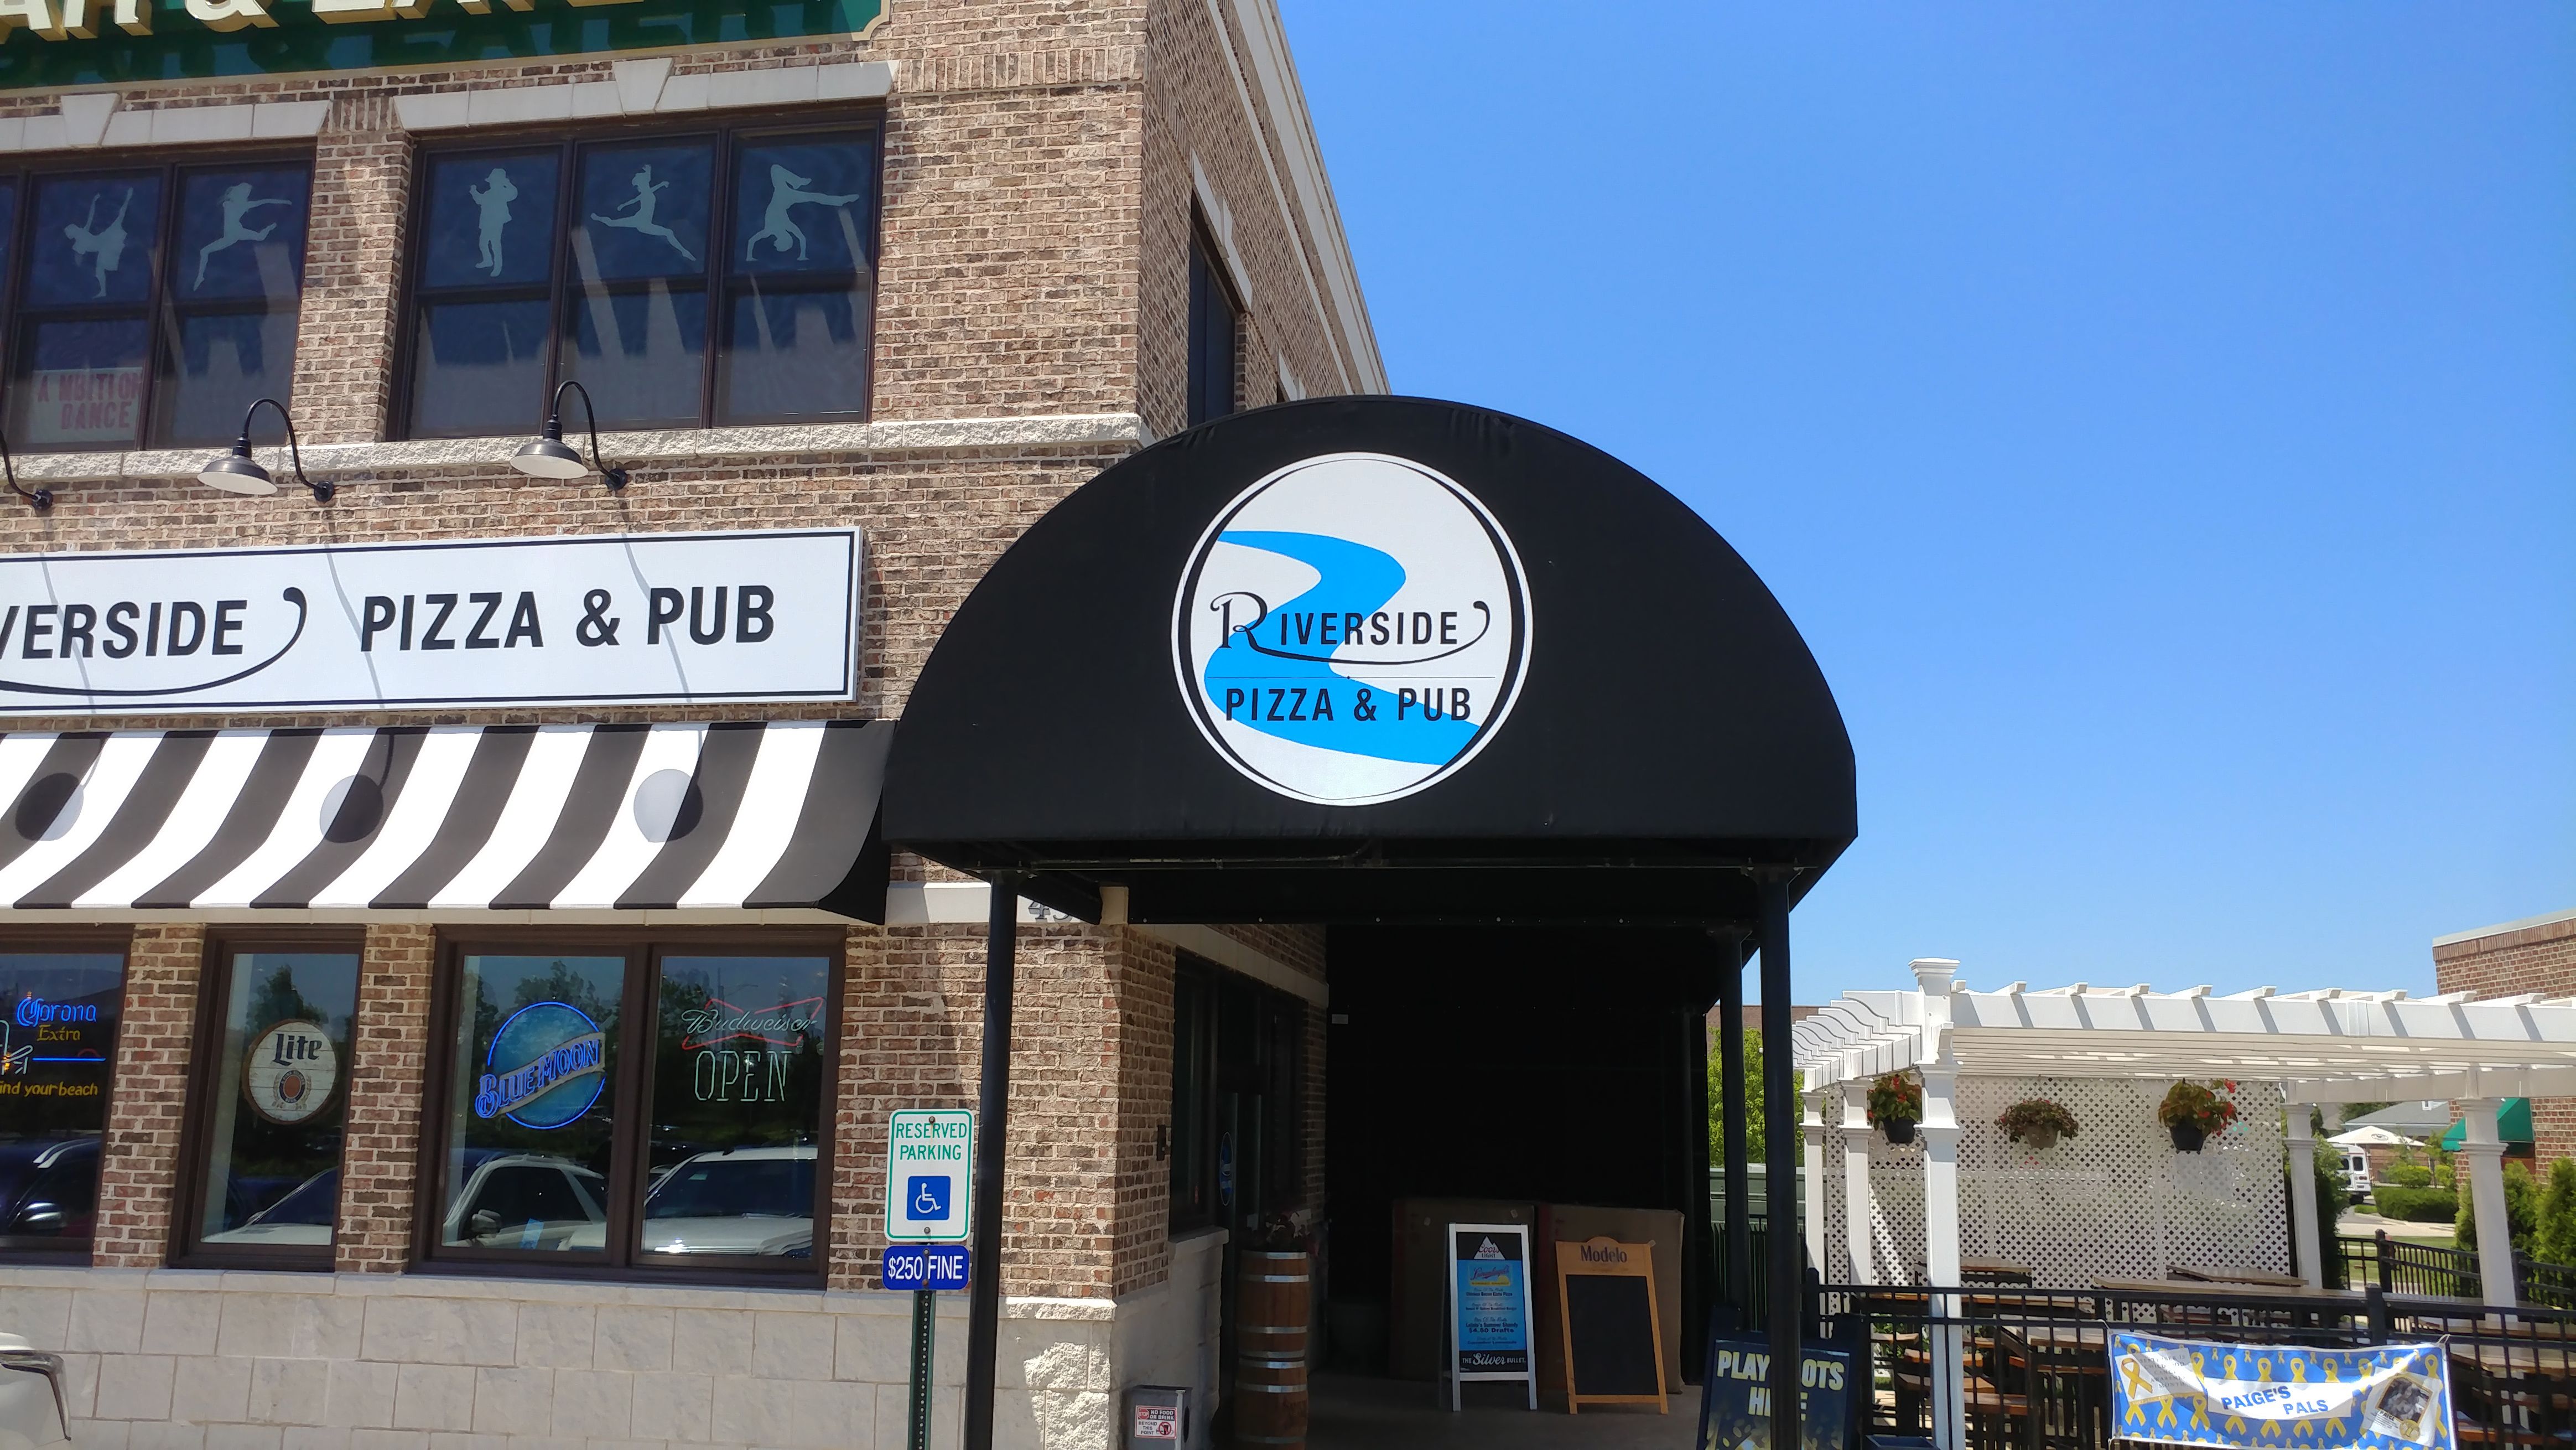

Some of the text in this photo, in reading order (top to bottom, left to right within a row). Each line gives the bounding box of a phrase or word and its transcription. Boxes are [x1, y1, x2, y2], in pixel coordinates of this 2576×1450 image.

[61, 401, 132, 430] DANCE
[361, 591, 543, 652] PIZZA
[576, 589, 620, 646] &
[647, 585, 774, 645] PUB
[1226, 688, 1471, 721] PIZZA & PUB
[17, 998, 97, 1027] Corona
[681, 1008, 817, 1034] Budweiser
[37, 1024, 81, 1041] Extra
[272, 1033, 323, 1066] Lite
[475, 1039, 600, 1118] BLUE MOON
[694, 1050, 792, 1101] OPEN
[24, 1084, 58, 1097] your
[58, 1081, 98, 1096] beach
[896, 1122, 967, 1139] RESERVED
[900, 1145, 962, 1161] PARKING
[1580, 1245, 1627, 1263] Modelo
[888, 1255, 964, 1280] $250 FINE
[1472, 1353, 1506, 1366] Silver
[1717, 1350, 1845, 1391] PLAY OTS
[2221, 1386, 2291, 1410] PAIGE'S
[2282, 1400, 2329, 1415] PALS
